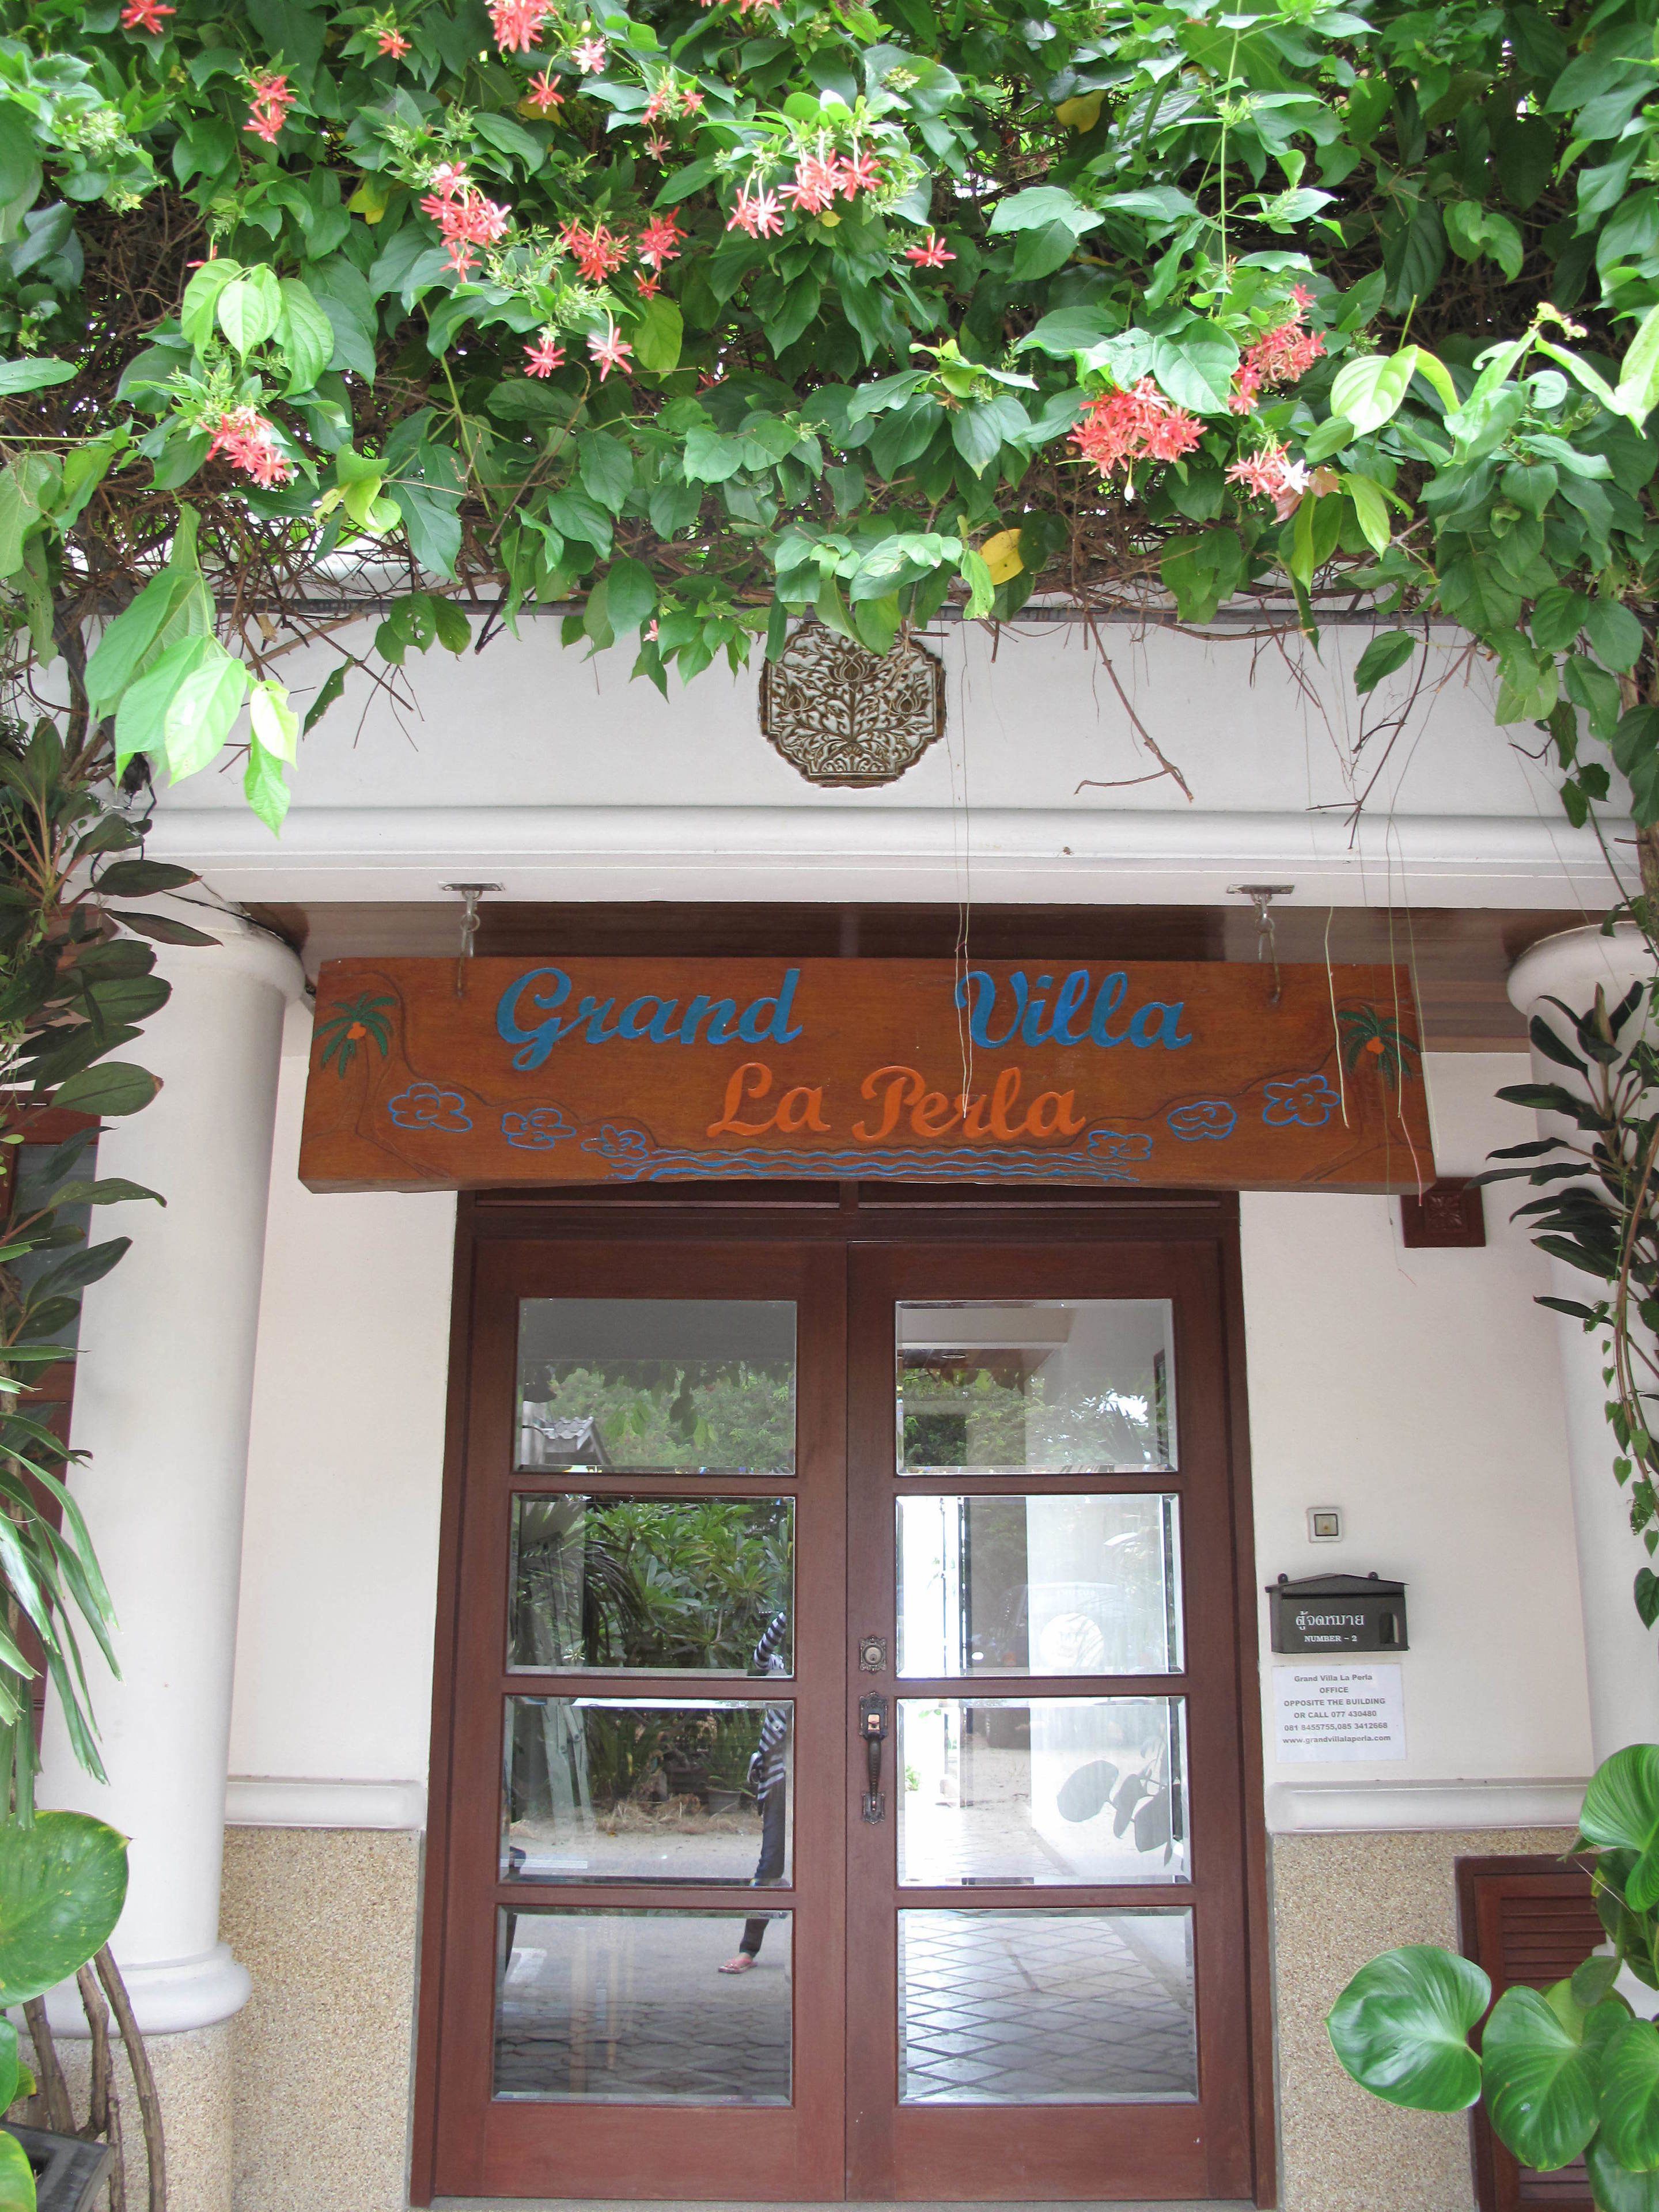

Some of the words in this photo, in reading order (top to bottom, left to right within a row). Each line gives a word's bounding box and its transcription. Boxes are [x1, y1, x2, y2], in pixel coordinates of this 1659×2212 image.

[497, 967, 803, 1071] Grand
[955, 969, 1192, 1050] Villa
[706, 1062, 831, 1138] La
[852, 1065, 1086, 1142] Perla
[1296, 1611, 1365, 1630] ตู้จดหมาย
[1282, 1735, 1391, 1744] www.grandvillalaperla.com
